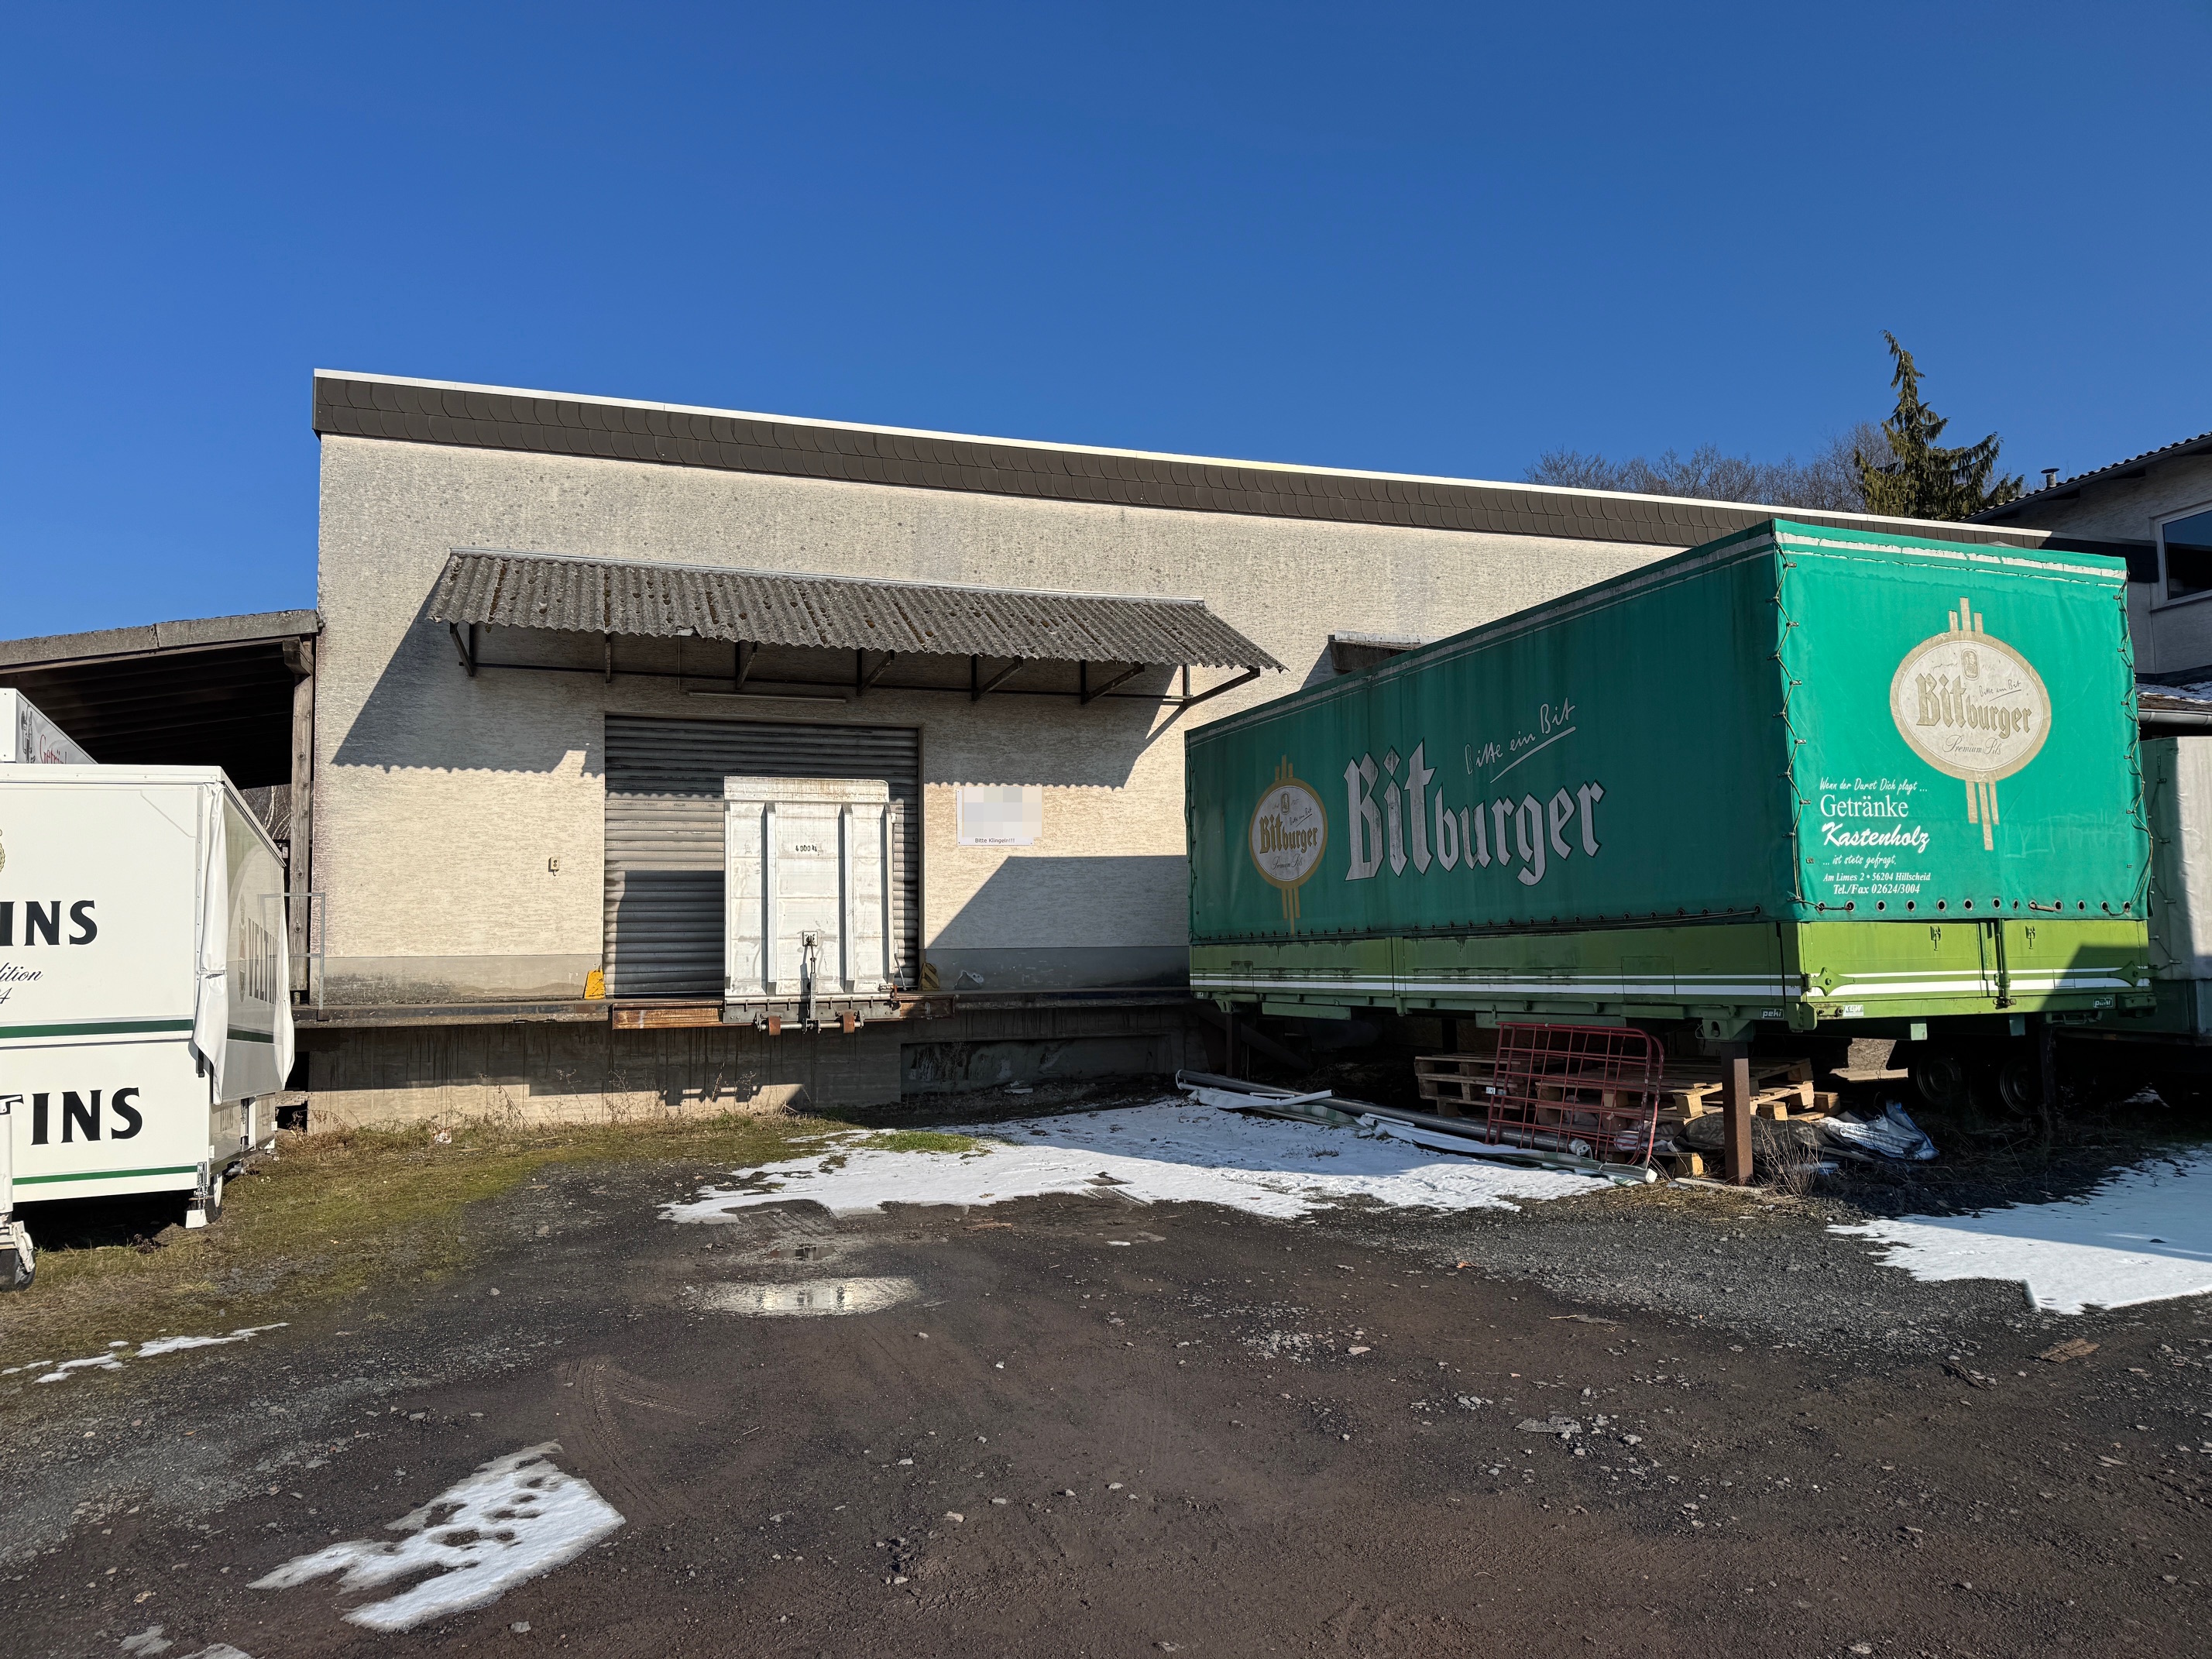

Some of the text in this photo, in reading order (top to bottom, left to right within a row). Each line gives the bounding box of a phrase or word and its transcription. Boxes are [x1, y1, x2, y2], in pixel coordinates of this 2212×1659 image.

[1915, 673, 2032, 739] Bitburger
[1464, 697, 1576, 775] Bitte ein Bit
[1942, 734, 2001, 755] Premium Pils
[1819, 777, 1837, 790] Wenn
[1839, 778, 1851, 789] der
[1880, 778, 1896, 791] Dich
[1897, 778, 1918, 795] plagt
[1343, 736, 1606, 887] Bitburger
[1820, 794, 1908, 817] Getränke
[1259, 812, 1318, 854] Bitburger
[1822, 821, 1930, 854] Kastenholz
[1832, 854, 1843, 864] ist
[1844, 854, 1863, 864] stets
[1864, 852, 1897, 868] gefragt.
[1822, 872, 1931, 881] Am Limes 2 56204 Hillscheid
[1833, 884, 1921, 895] Tel./Fax 02624/3004
[248, 917, 278, 1006] VELTIN
[1762, 1008, 1782, 1018] peki
